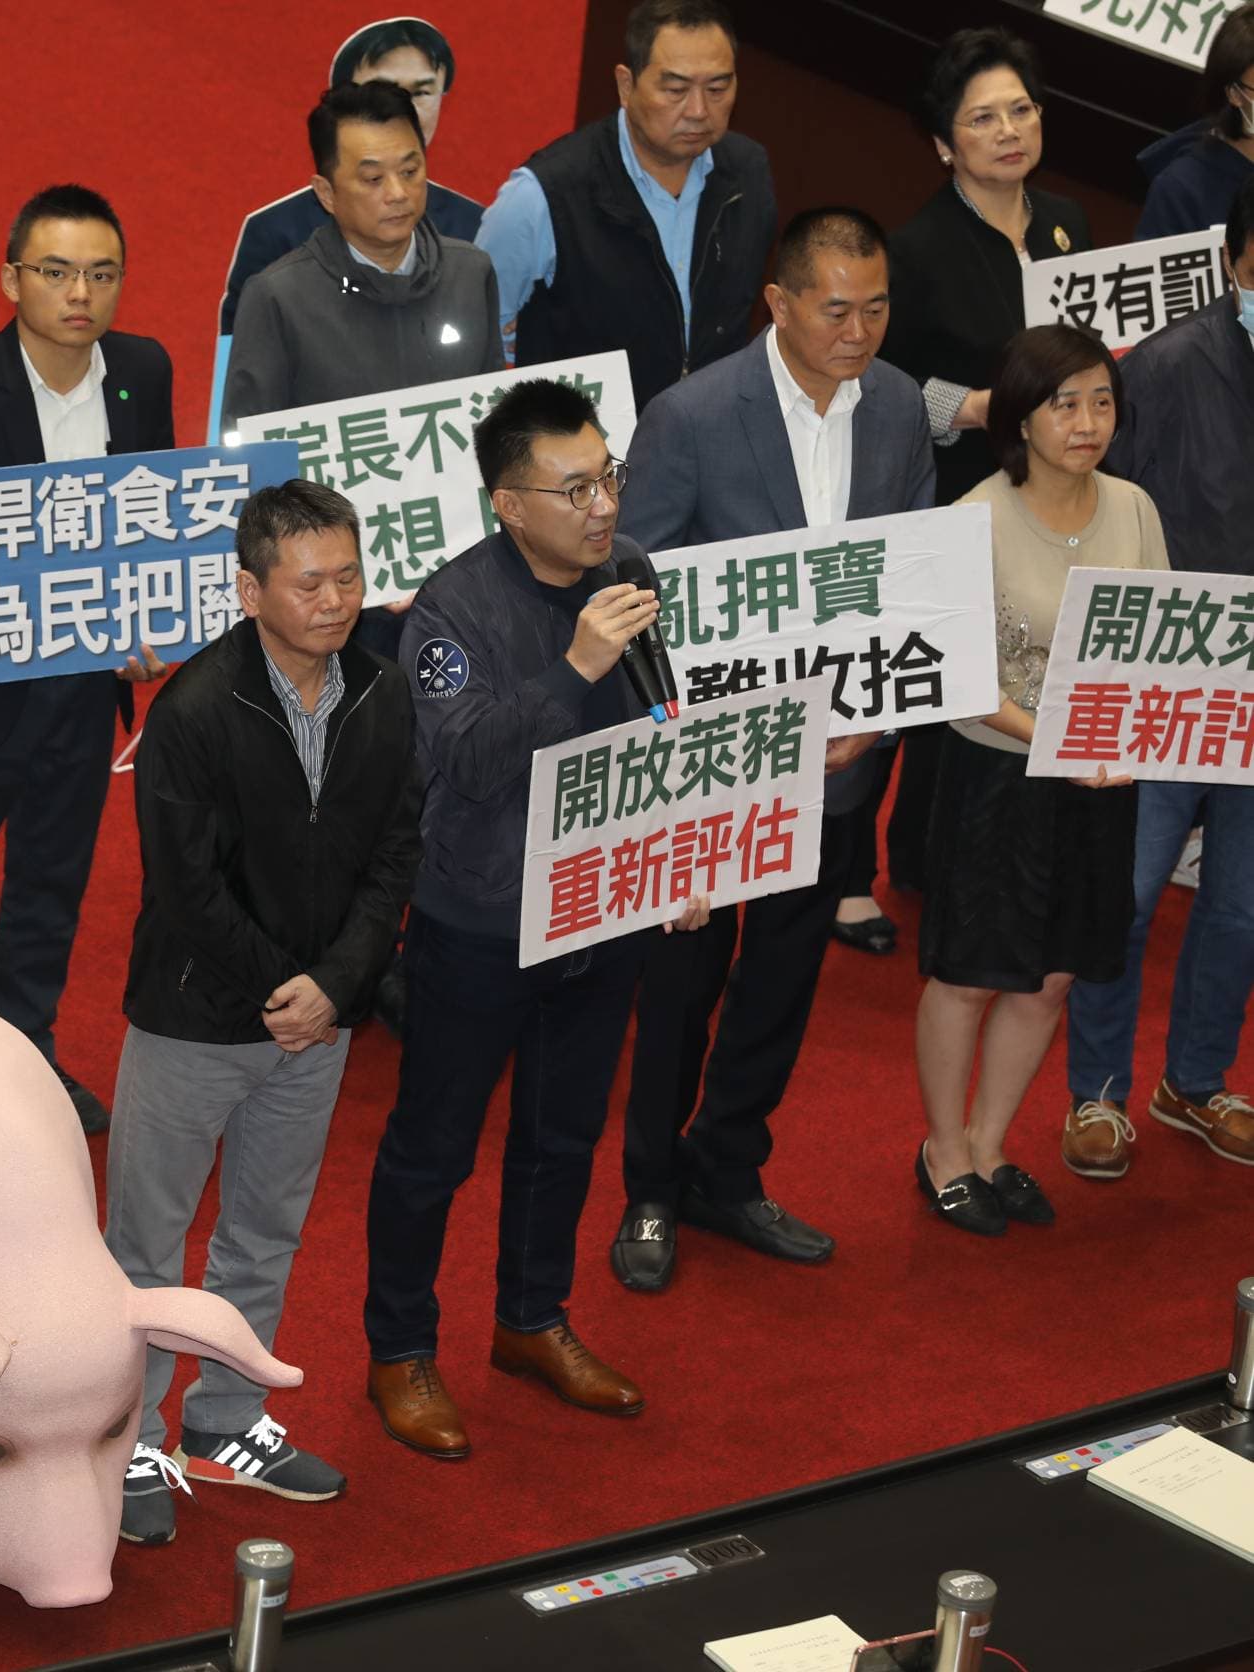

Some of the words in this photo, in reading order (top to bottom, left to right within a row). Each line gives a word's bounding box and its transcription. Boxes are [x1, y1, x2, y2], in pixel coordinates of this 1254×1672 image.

[1049, 247, 1232, 340] 沒有罰
[552, 696, 807, 841] 開放萊豬
[545, 796, 799, 942] 重新評估
